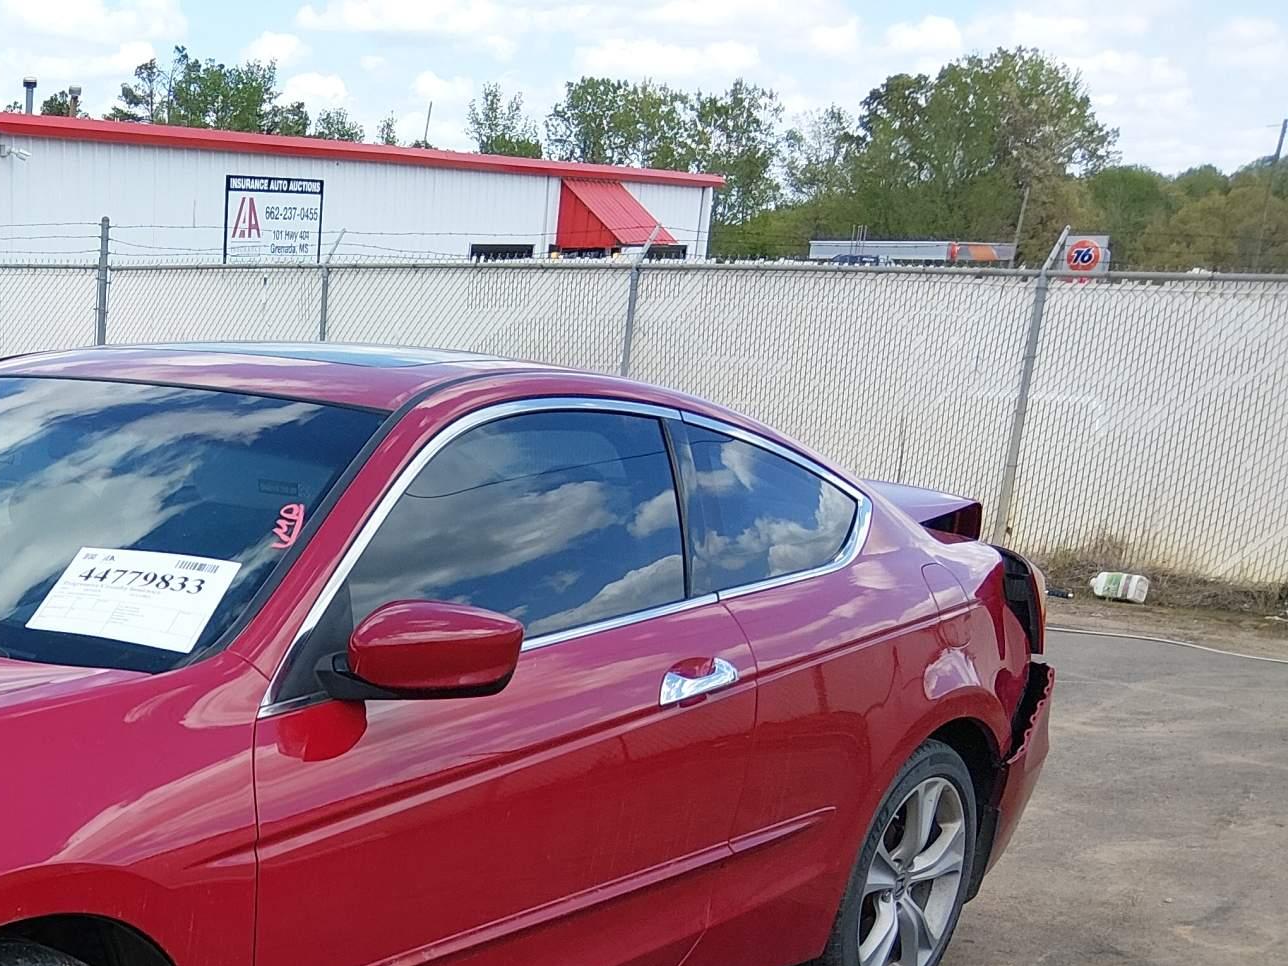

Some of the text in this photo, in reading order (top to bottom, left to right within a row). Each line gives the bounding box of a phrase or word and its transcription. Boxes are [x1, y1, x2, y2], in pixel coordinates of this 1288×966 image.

[229, 177, 321, 193] INSURANCE AUTO AUCTIONS
[265, 205, 318, 221] 662-237-0455
[273, 230, 284, 240] 101
[284, 230, 299, 242] Hwy
[298, 243, 309, 254] MS
[1071, 246, 1095, 265] 76
[79, 567, 206, 595] 44779833
